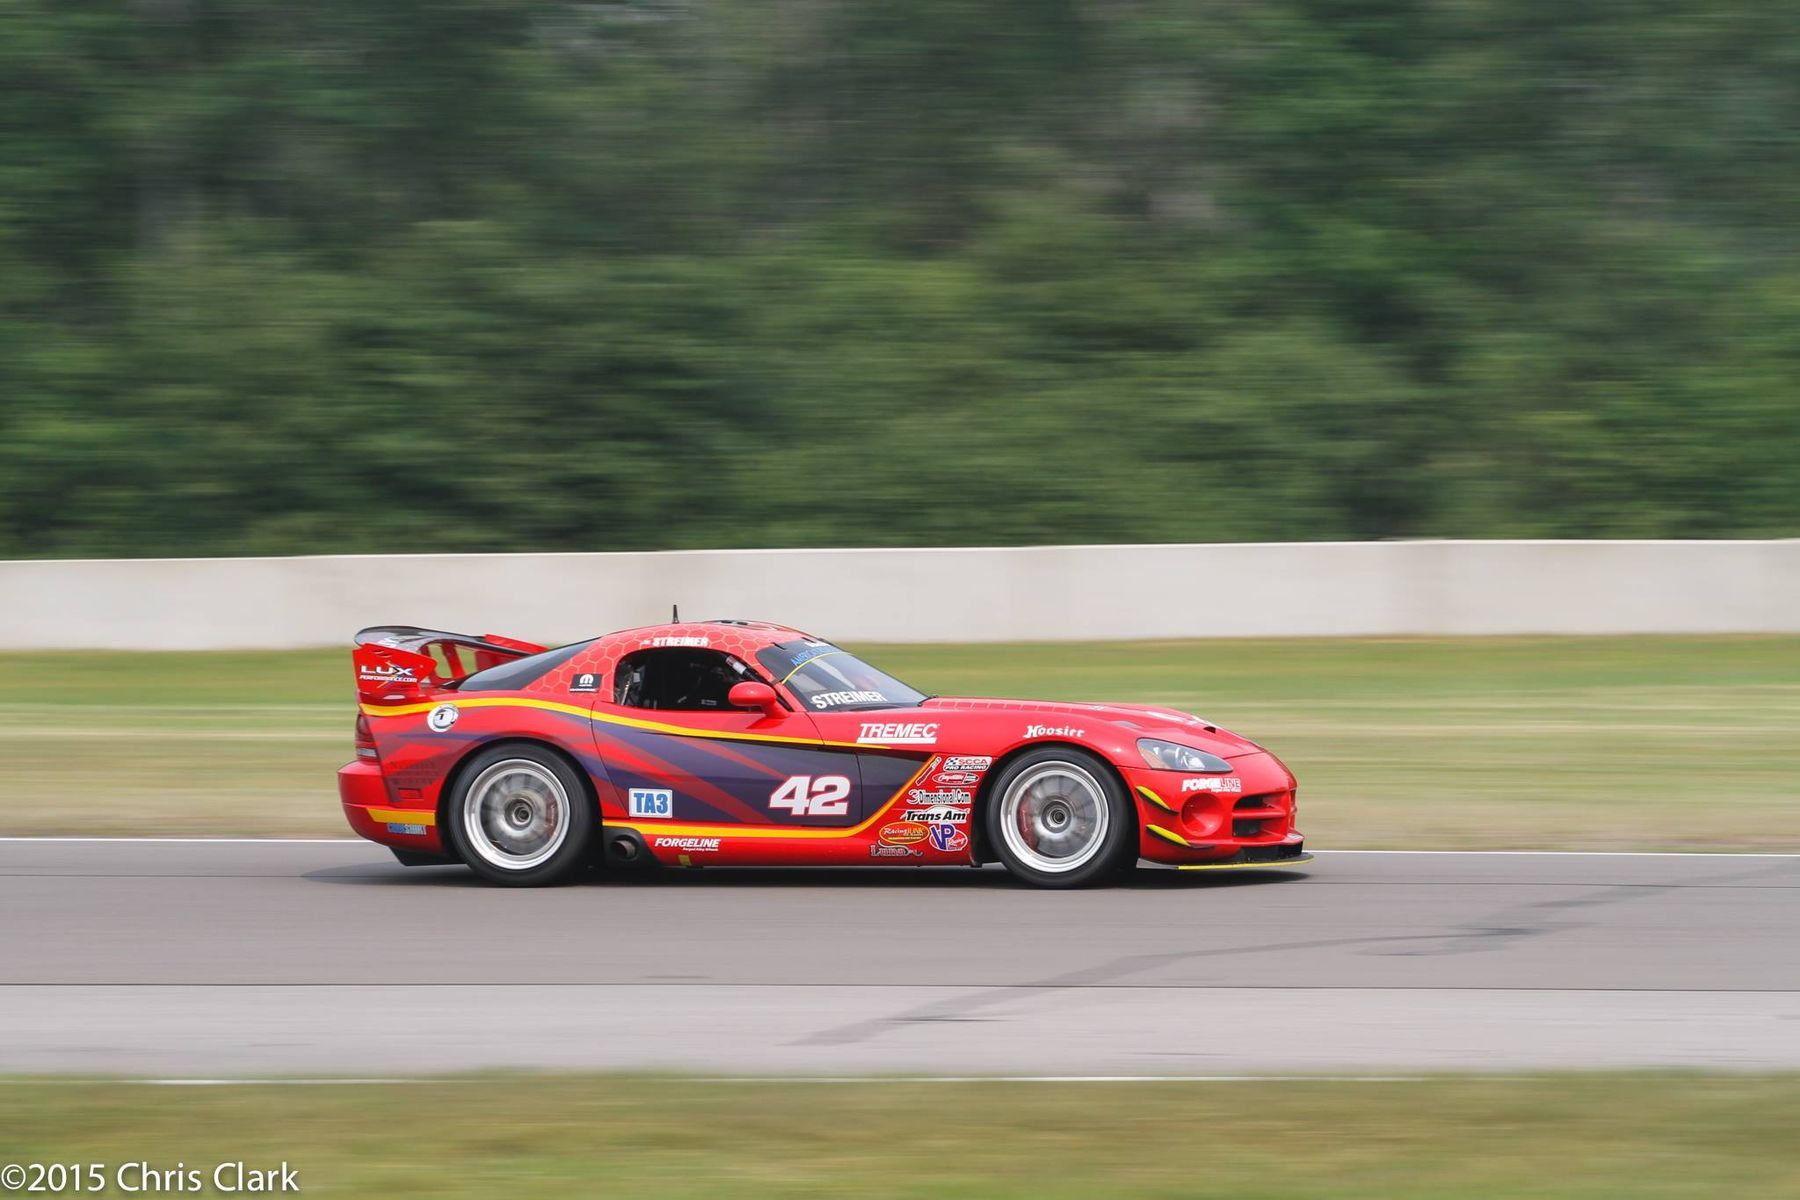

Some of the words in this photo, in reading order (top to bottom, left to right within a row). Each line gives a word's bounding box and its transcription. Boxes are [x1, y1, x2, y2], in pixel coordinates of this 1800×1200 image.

[653, 637, 708, 647] STREIMER
[361, 665, 413, 676] LUX
[811, 691, 888, 709] STREIMER
[860, 723, 937, 738] TREMEC
[1181, 777, 1241, 792] FORGELINE
[633, 793, 668, 813] TA3
[768, 775, 850, 816] 42
[906, 810, 941, 821] Trans
[942, 810, 966, 821] Am
[655, 838, 721, 848] FORGELINE
[930, 824, 955, 850] VP
